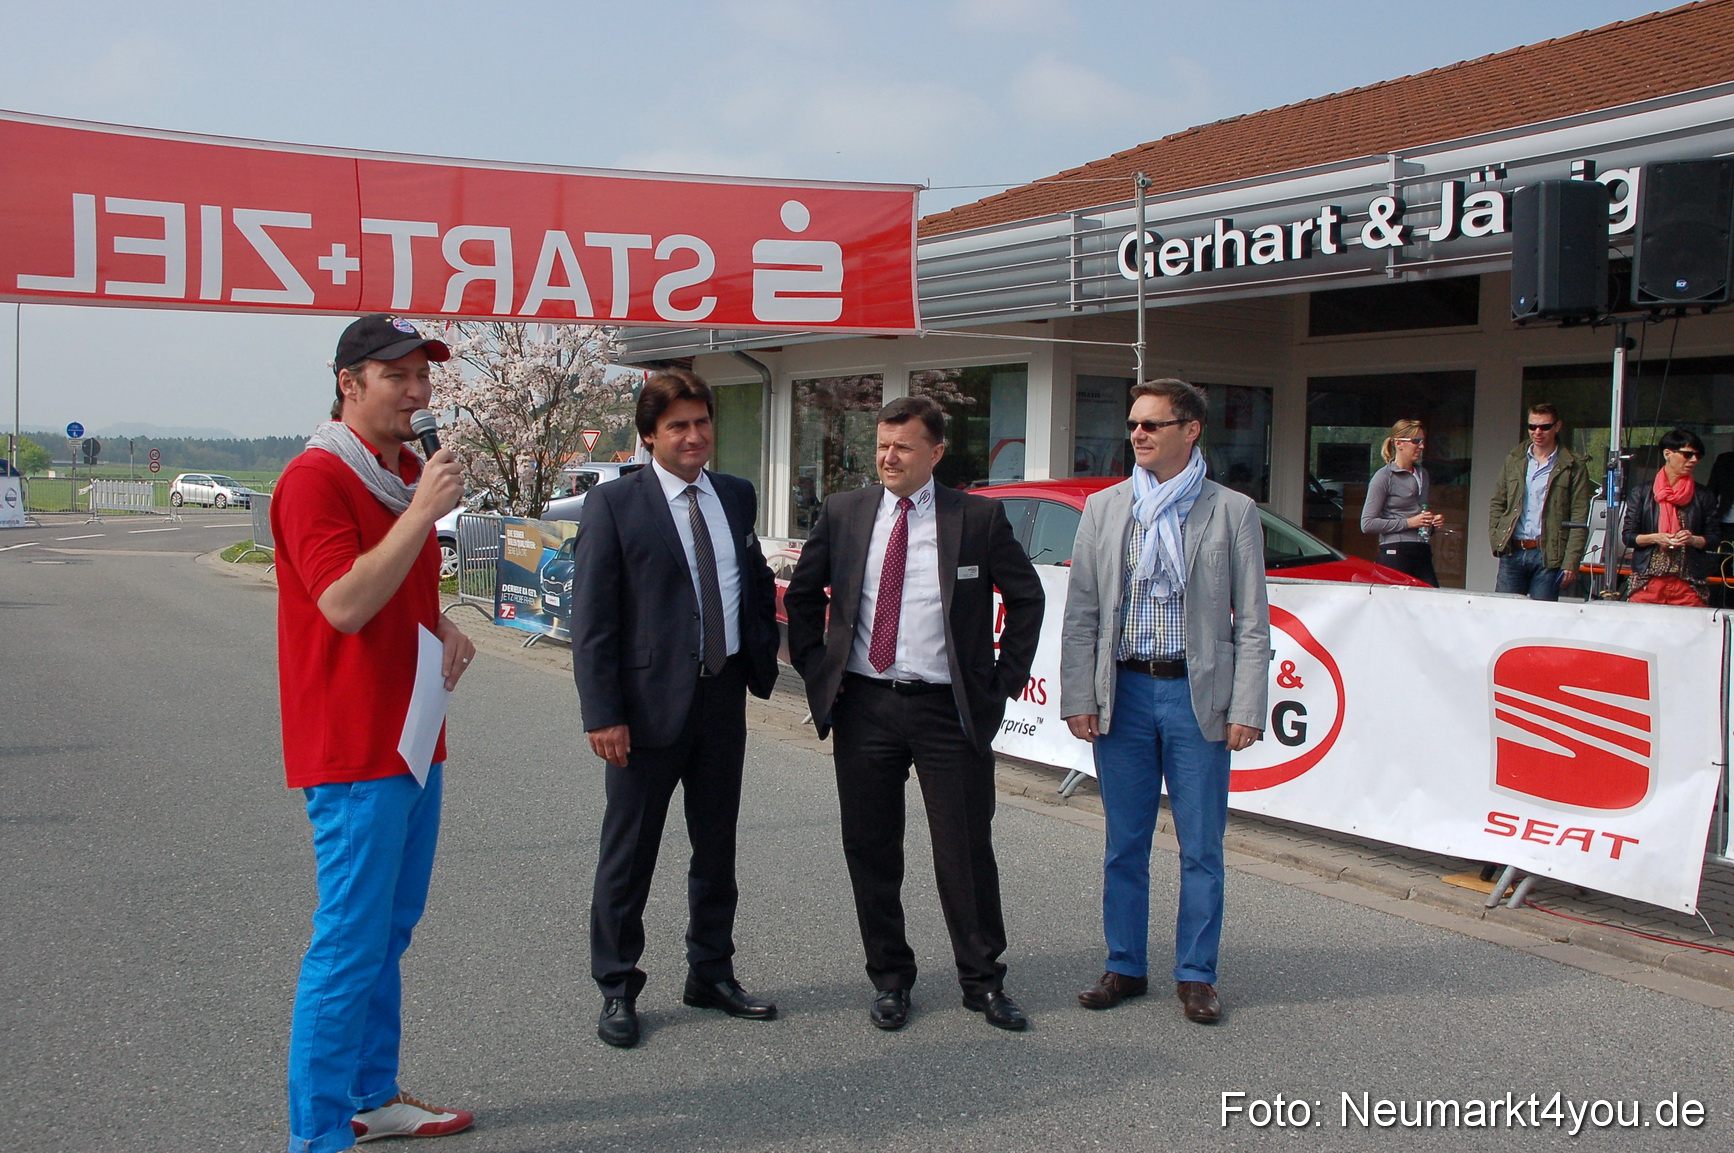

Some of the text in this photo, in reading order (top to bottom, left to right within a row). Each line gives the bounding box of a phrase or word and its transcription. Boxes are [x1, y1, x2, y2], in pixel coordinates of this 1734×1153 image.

[1117, 160, 1642, 280] Gerhart & Jäg
[1277, 660, 1304, 689] &
[1018, 676, 1047, 706] RS
[1001, 718, 1037, 737] rprise
[1484, 811, 1640, 860] SEAT
